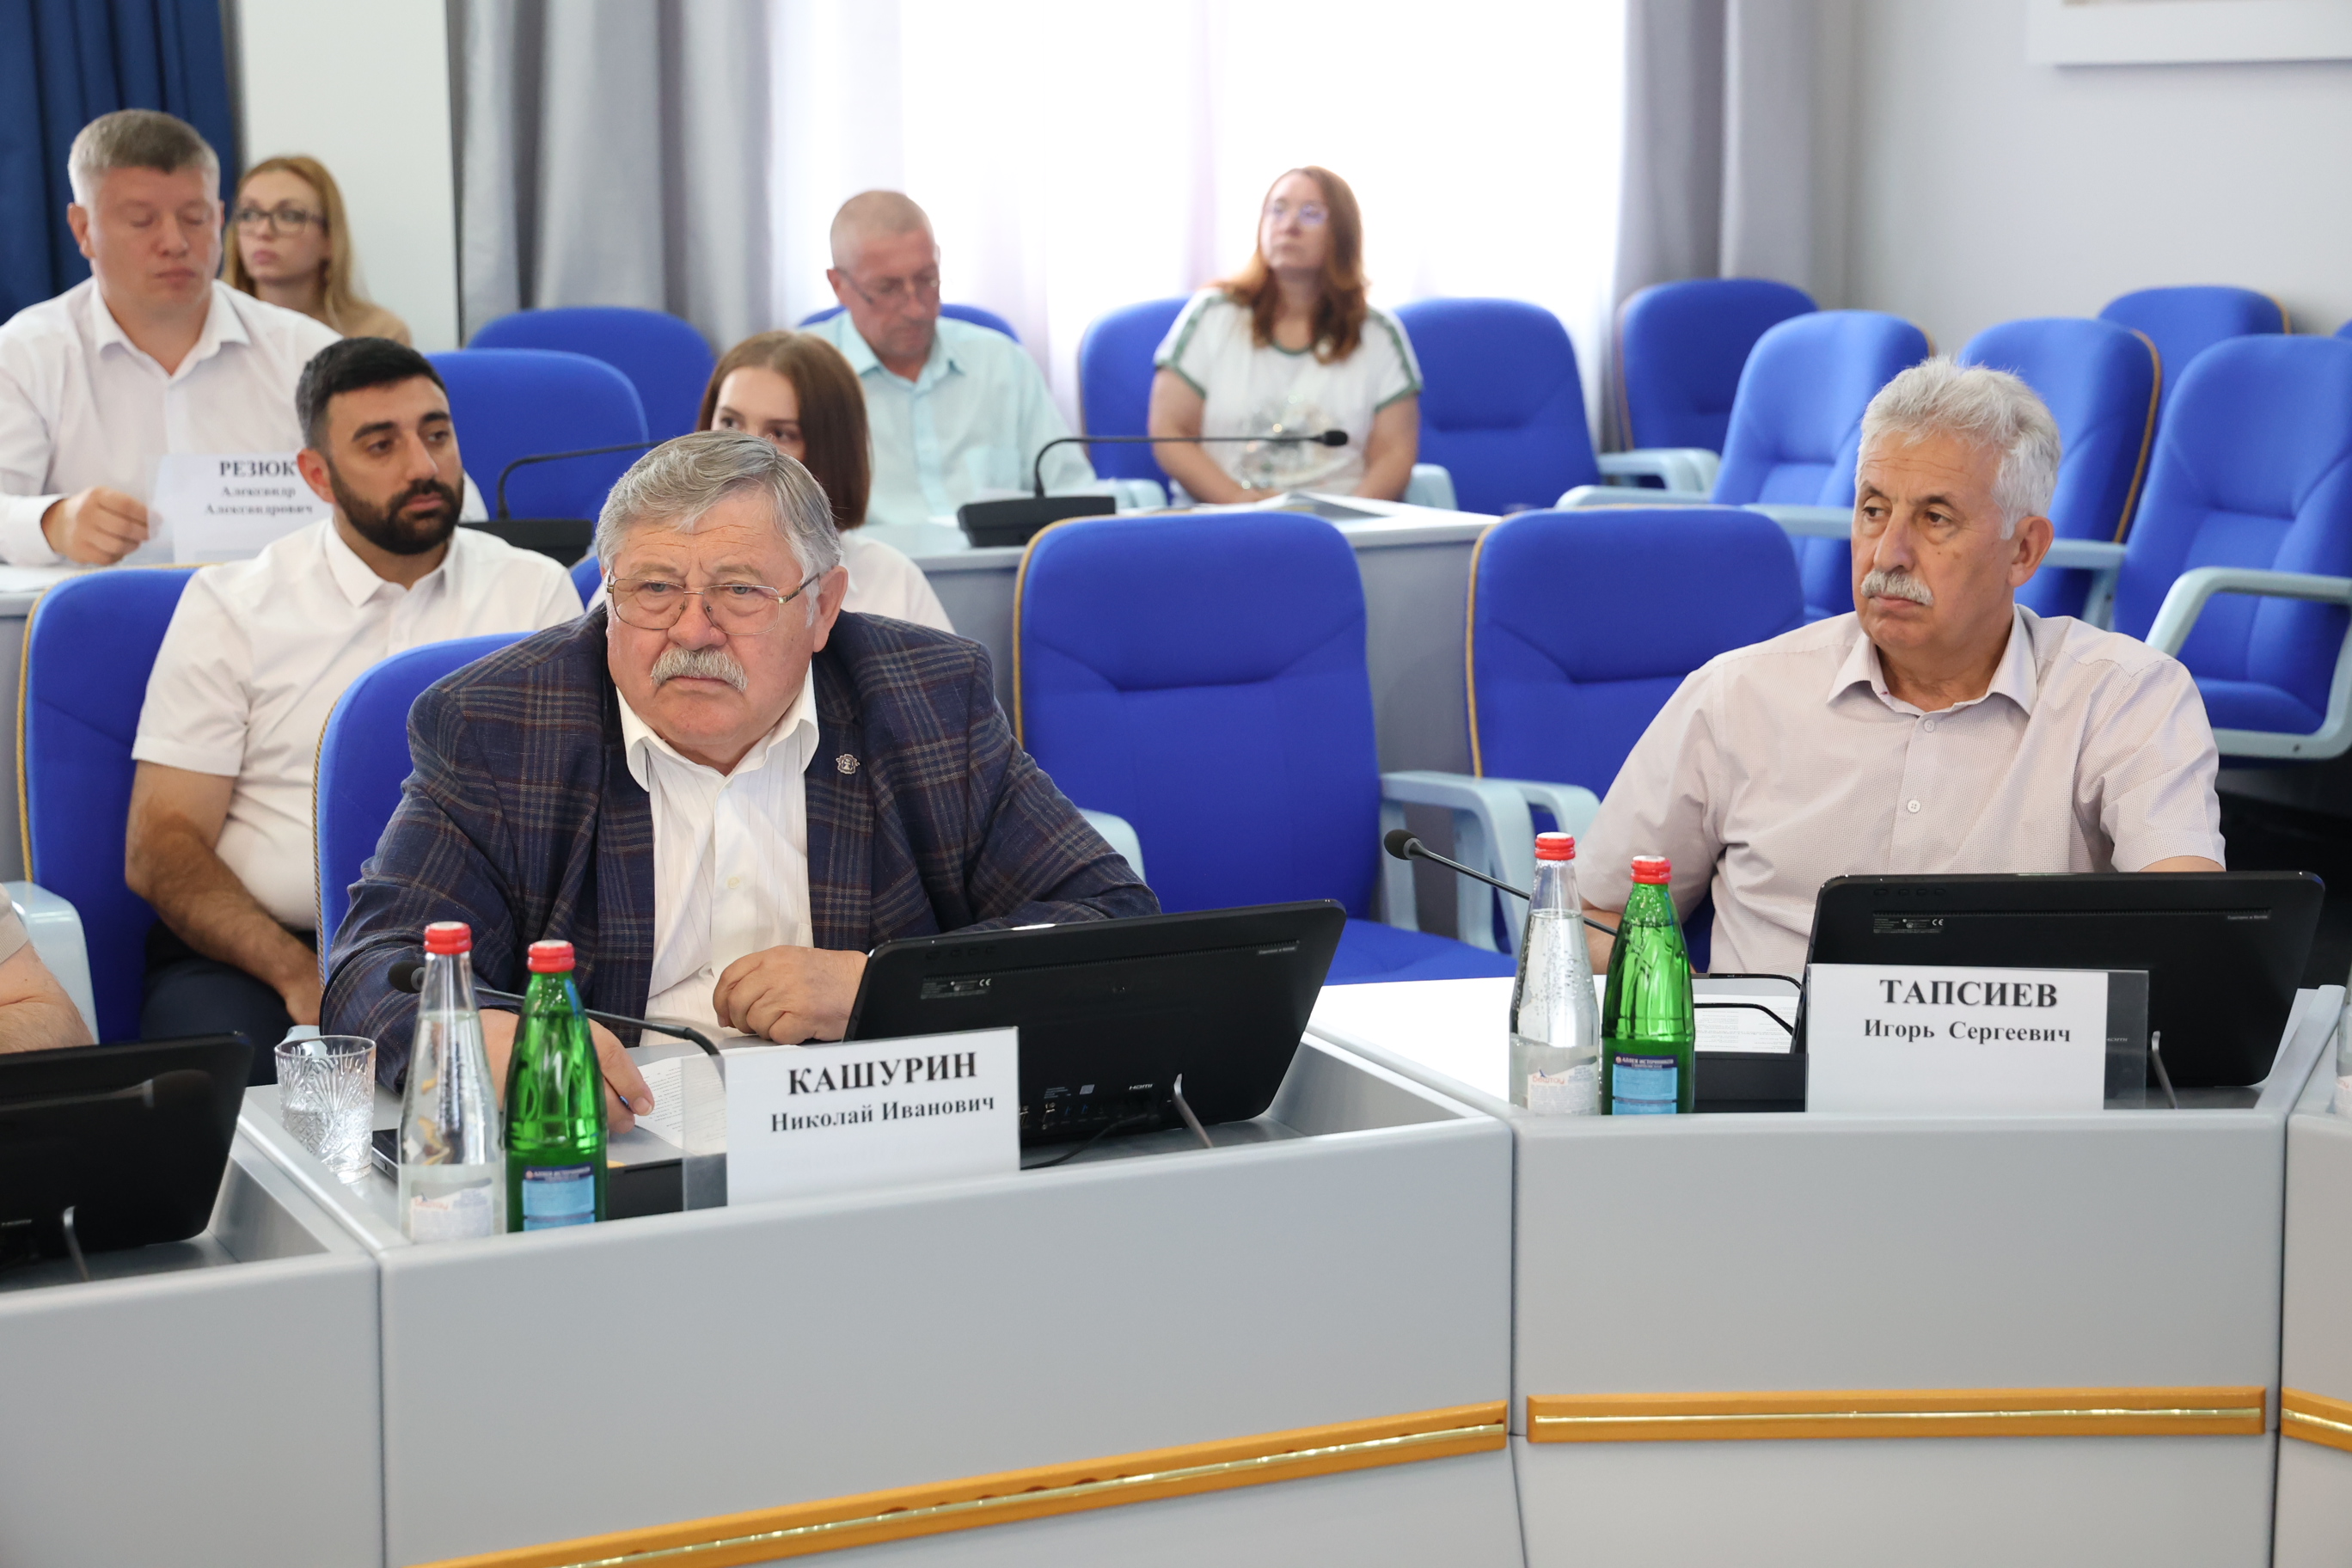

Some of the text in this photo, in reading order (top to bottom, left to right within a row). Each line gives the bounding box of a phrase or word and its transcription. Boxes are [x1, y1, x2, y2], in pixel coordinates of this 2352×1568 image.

[222, 487, 296, 499] Александр
[206, 504, 314, 517] Александрович
[1879, 979, 2058, 1008] ТАПСИЕВ
[1864, 1019, 2071, 1044] Игорь Сергеевич
[788, 1051, 977, 1095] КАШУРИН
[771, 1096, 995, 1132] Николай Иванович
